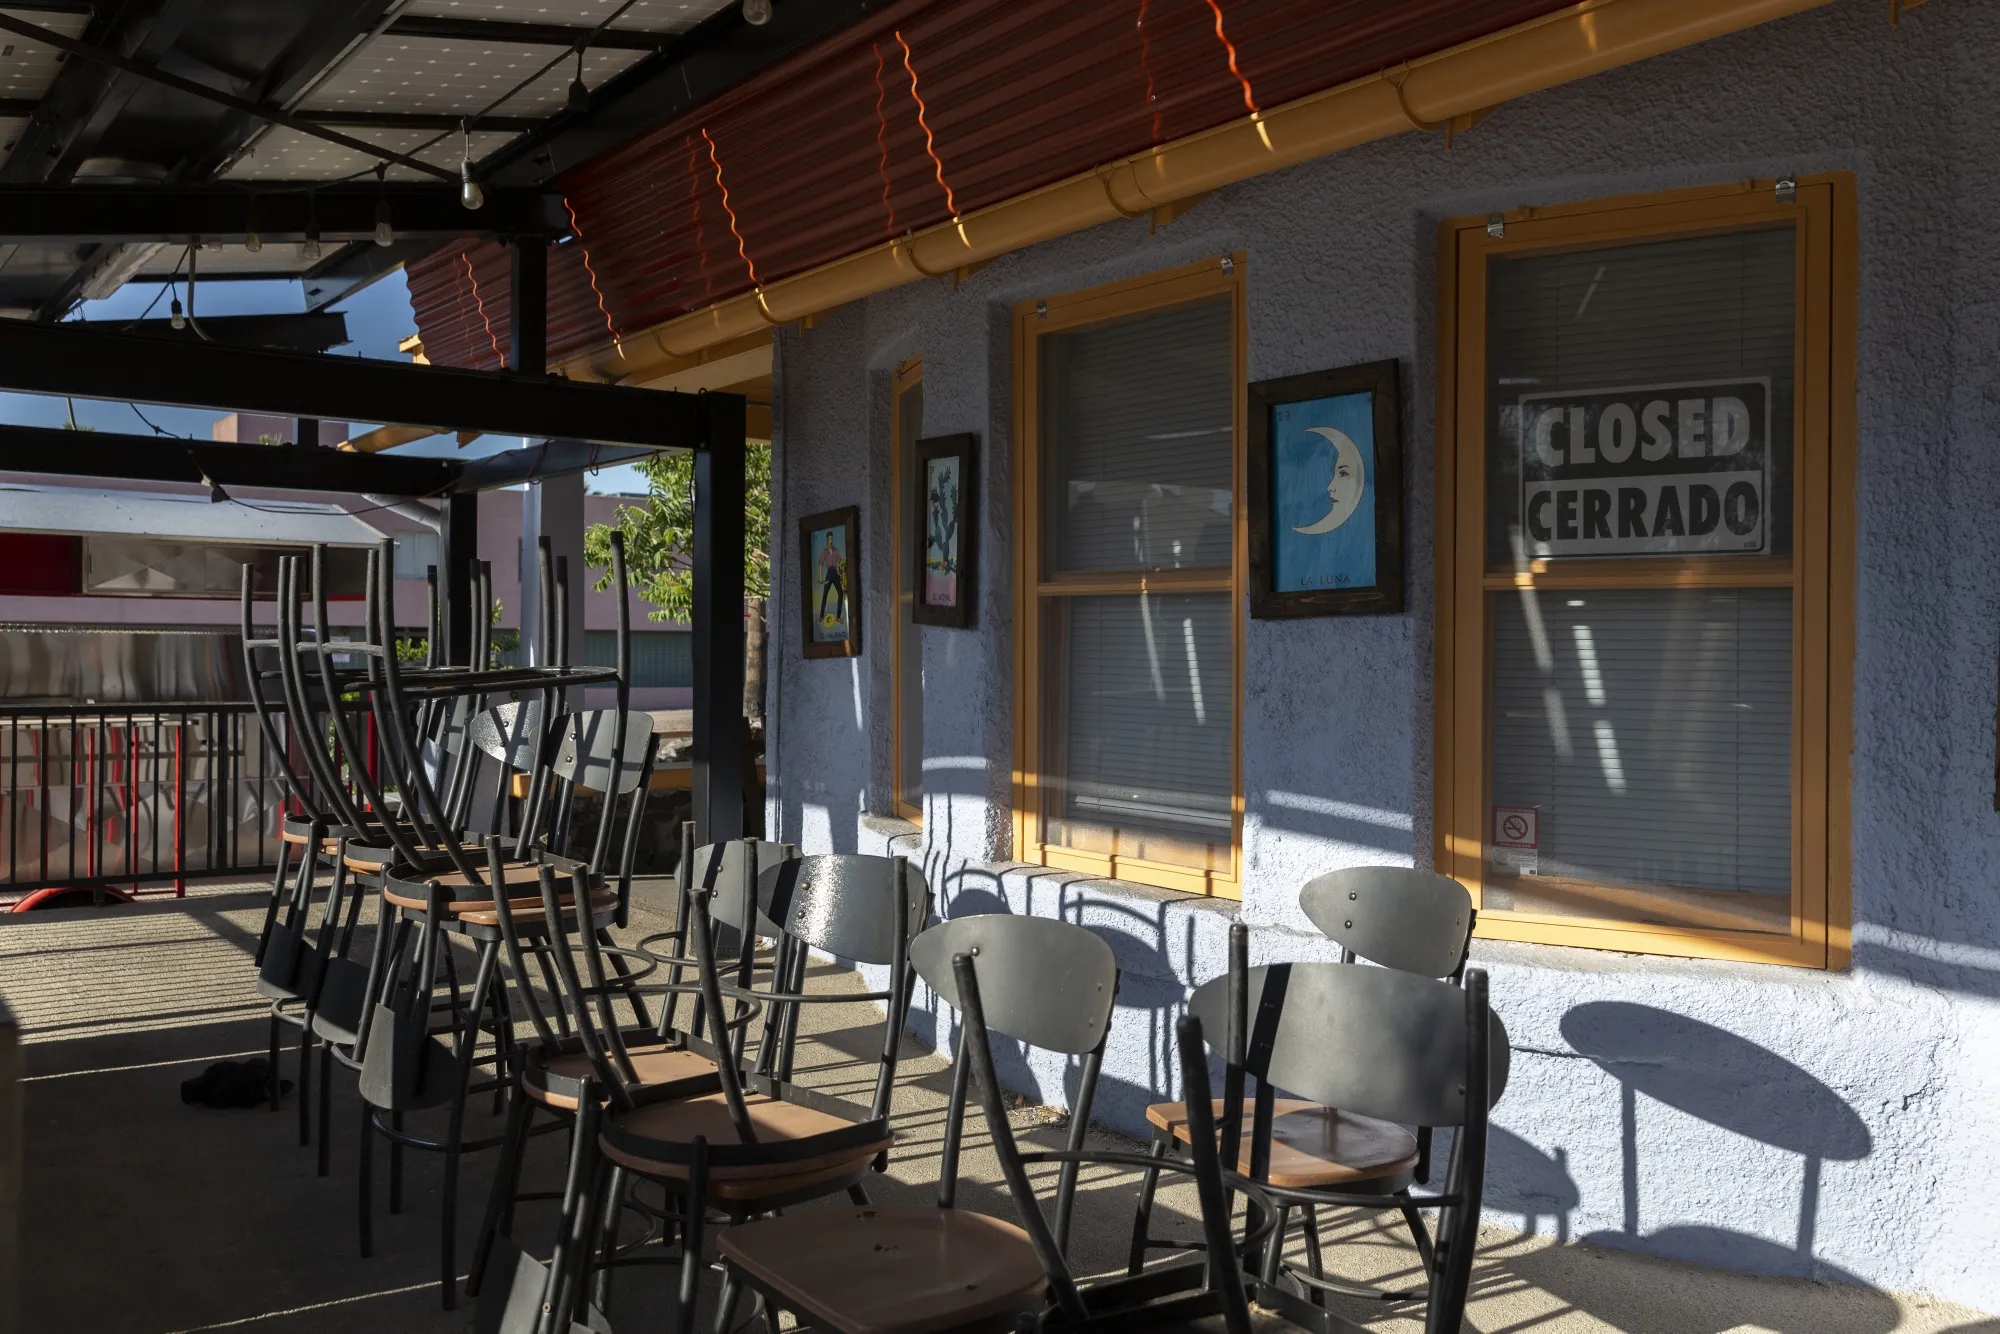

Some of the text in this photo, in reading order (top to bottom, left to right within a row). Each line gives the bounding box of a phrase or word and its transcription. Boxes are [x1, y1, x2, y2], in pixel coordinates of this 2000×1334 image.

[1535, 396, 1750, 467] CLOSED
[1527, 480, 1760, 542] CERRADO
[1300, 574, 1351, 586] LA LUNA
